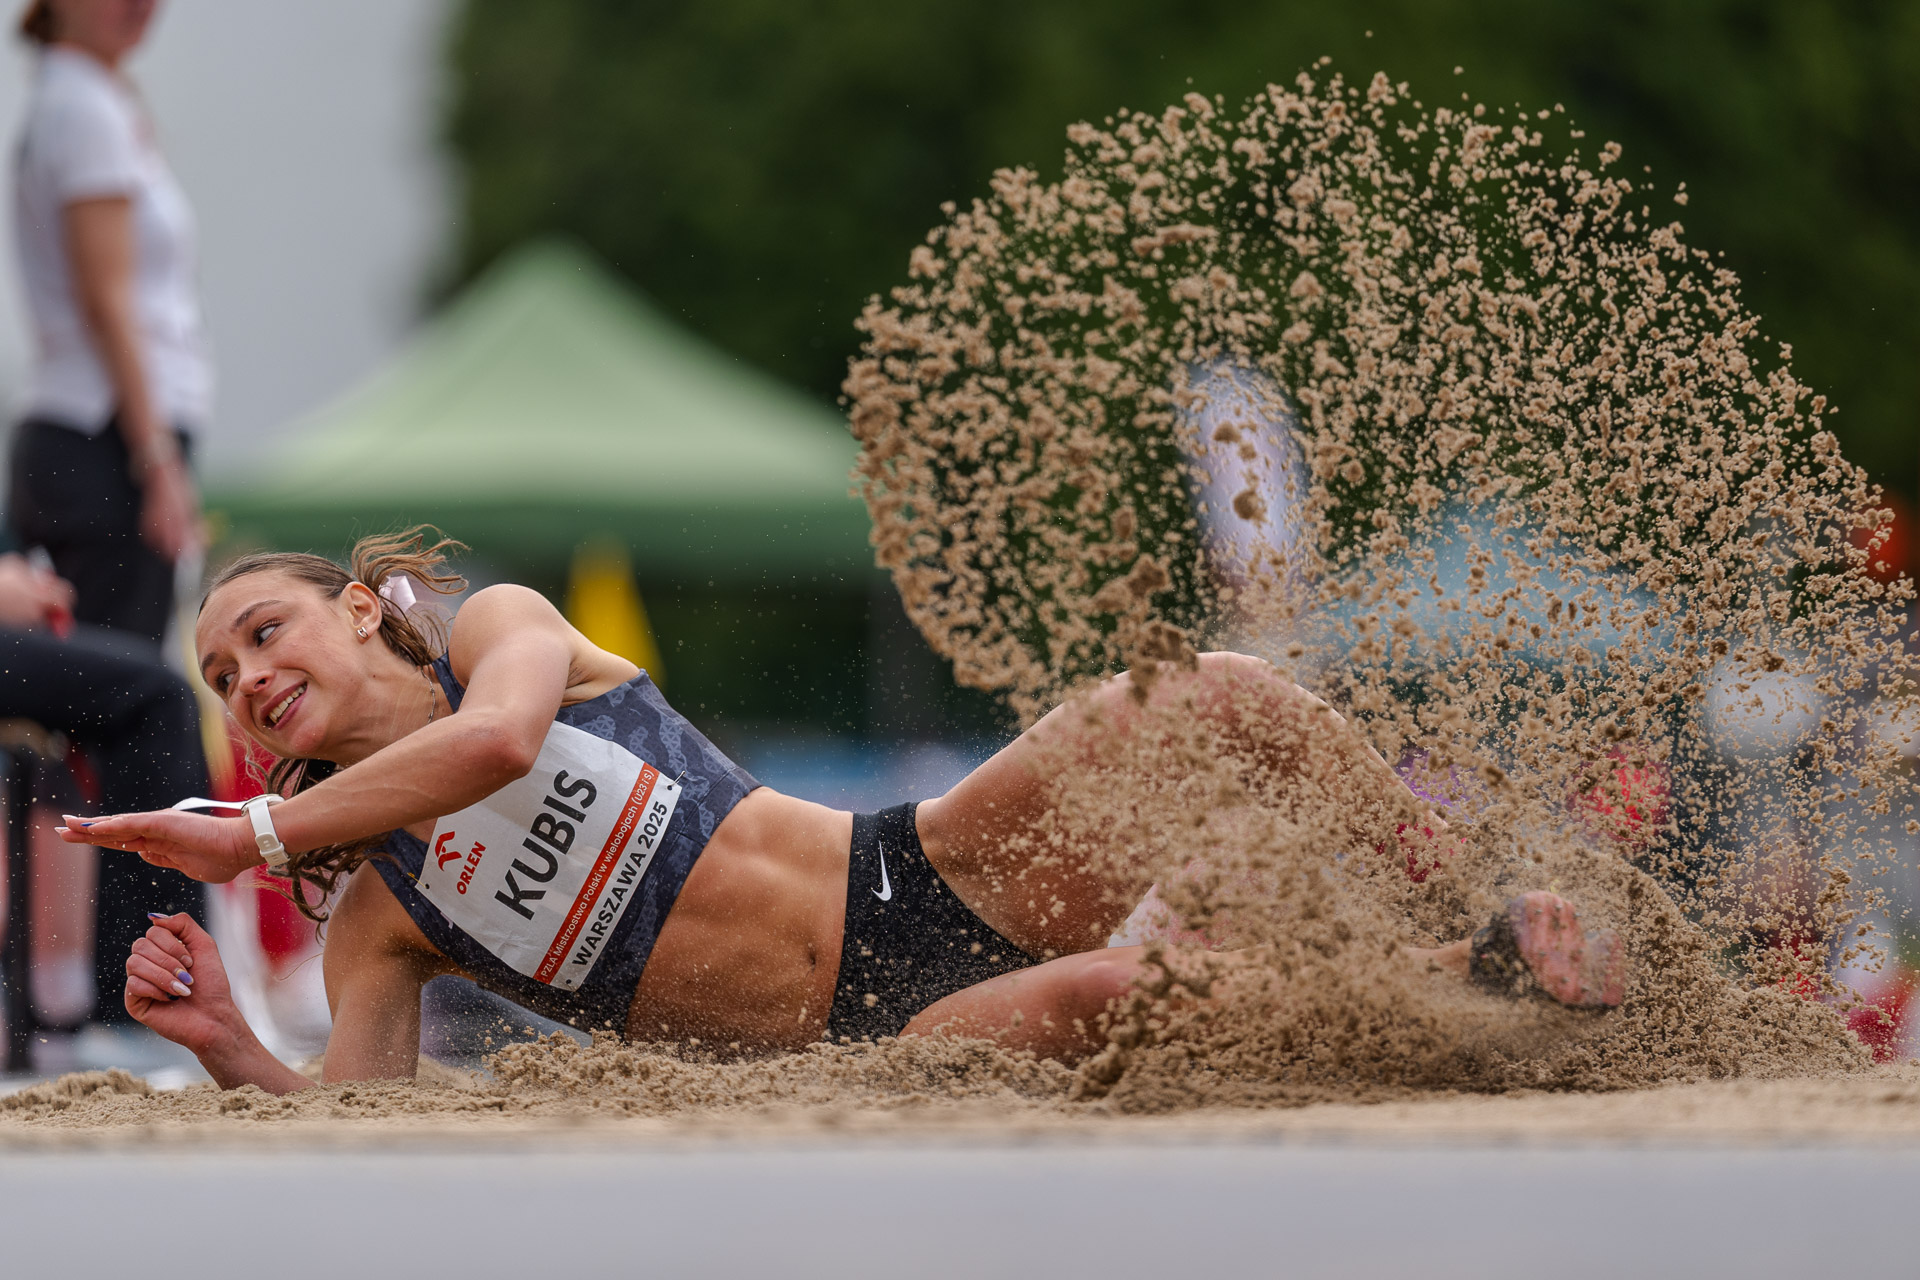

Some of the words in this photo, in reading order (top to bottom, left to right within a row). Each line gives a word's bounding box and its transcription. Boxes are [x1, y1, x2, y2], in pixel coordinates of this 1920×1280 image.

[456, 840, 487, 895] ORLEN
[494, 769, 598, 921] KUBIS
[540, 956, 558, 977] PZLA
[553, 901, 588, 957] Mistrzostwa
[583, 872, 603, 901] Polski
[599, 863, 608, 873] w
[604, 805, 638, 862] wielobojach
[631, 783, 648, 805] (U23
[643, 769, 655, 780] S)
[572, 852, 647, 966] WARSZAWA
[637, 801, 668, 850] 2025
